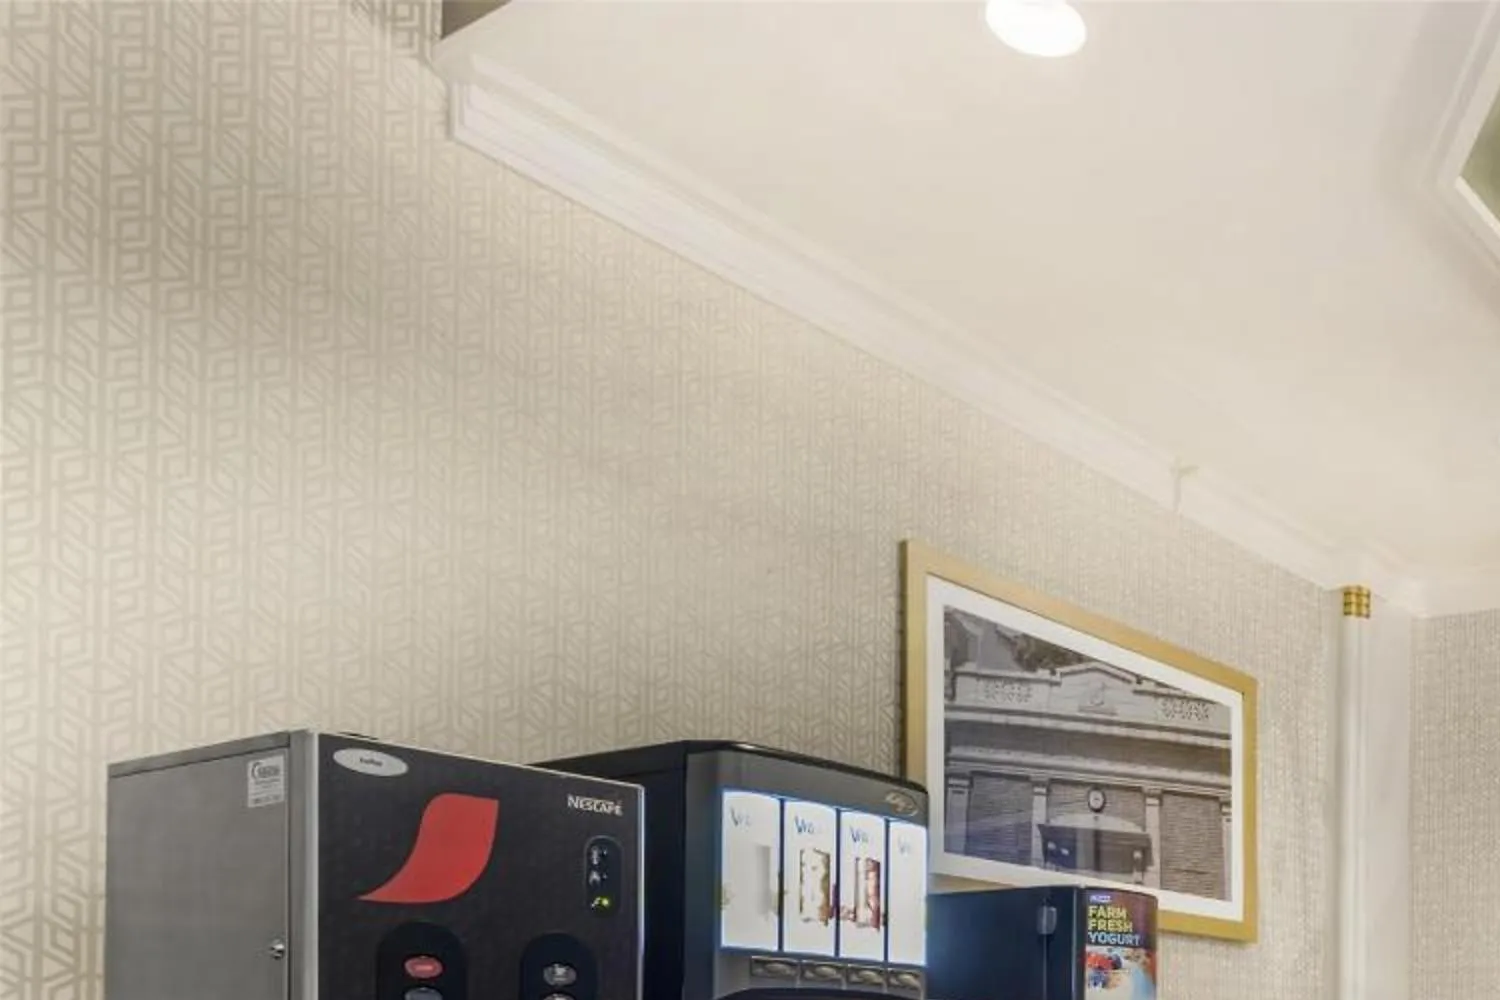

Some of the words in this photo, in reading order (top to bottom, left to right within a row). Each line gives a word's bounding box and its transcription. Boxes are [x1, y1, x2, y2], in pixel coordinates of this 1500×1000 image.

[1088, 905, 1127, 919] FARM
[1088, 918, 1134, 933] FRESH
[1088, 932, 1140, 946] YOGURT
